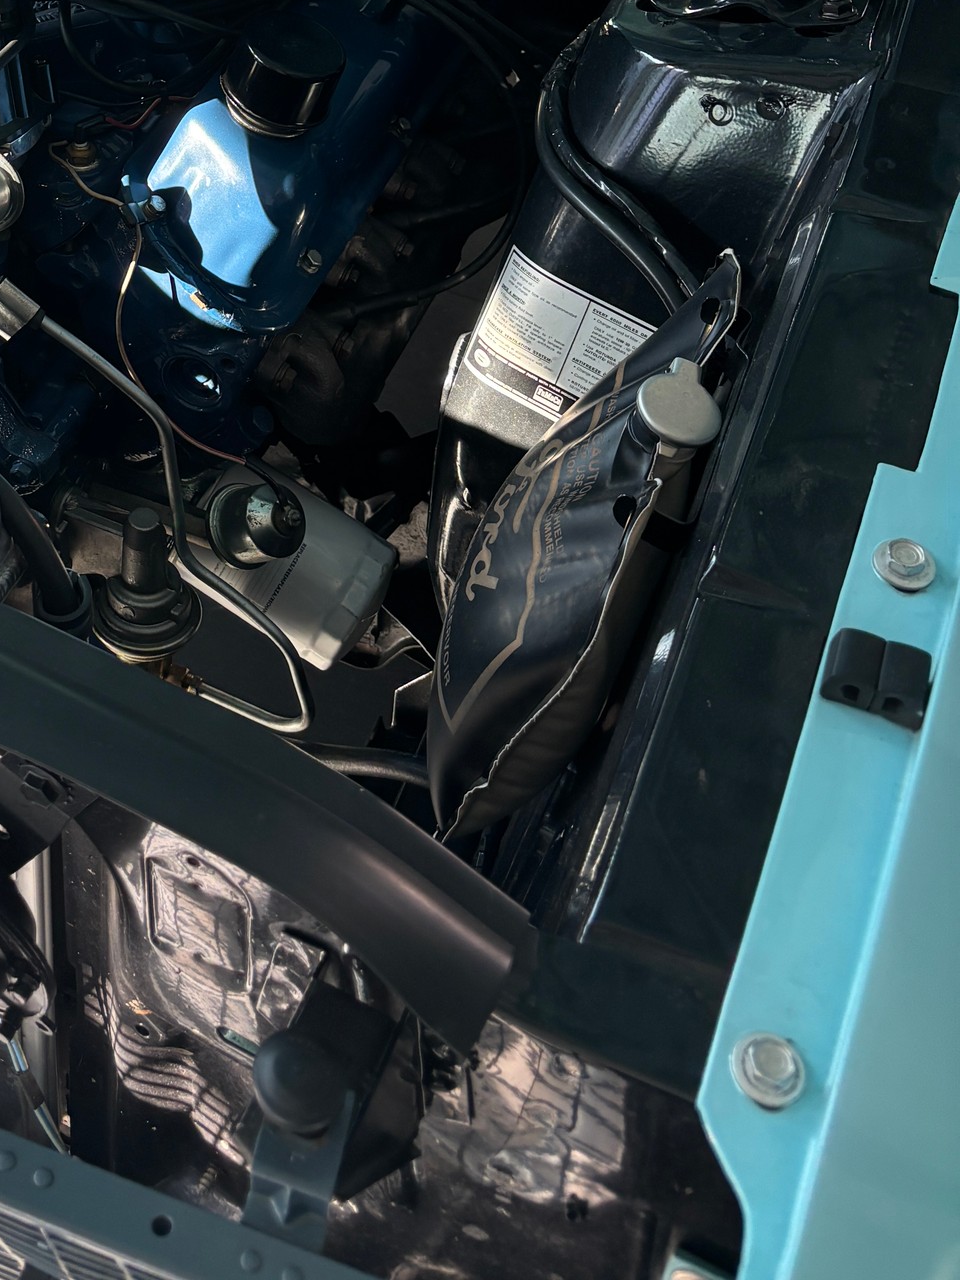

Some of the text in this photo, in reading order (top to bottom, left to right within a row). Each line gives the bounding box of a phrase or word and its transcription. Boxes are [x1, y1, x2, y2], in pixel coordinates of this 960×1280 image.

[593, 309, 608, 318] EVERY
[624, 324, 638, 333] MILES
[572, 357, 601, 374] ANTIFREEZE
[595, 350, 616, 362] ROTUNDA
[572, 433, 605, 502] CAUTION
[574, 465, 587, 488] USE
[560, 483, 572, 496] AS
[465, 438, 563, 601] Ford
